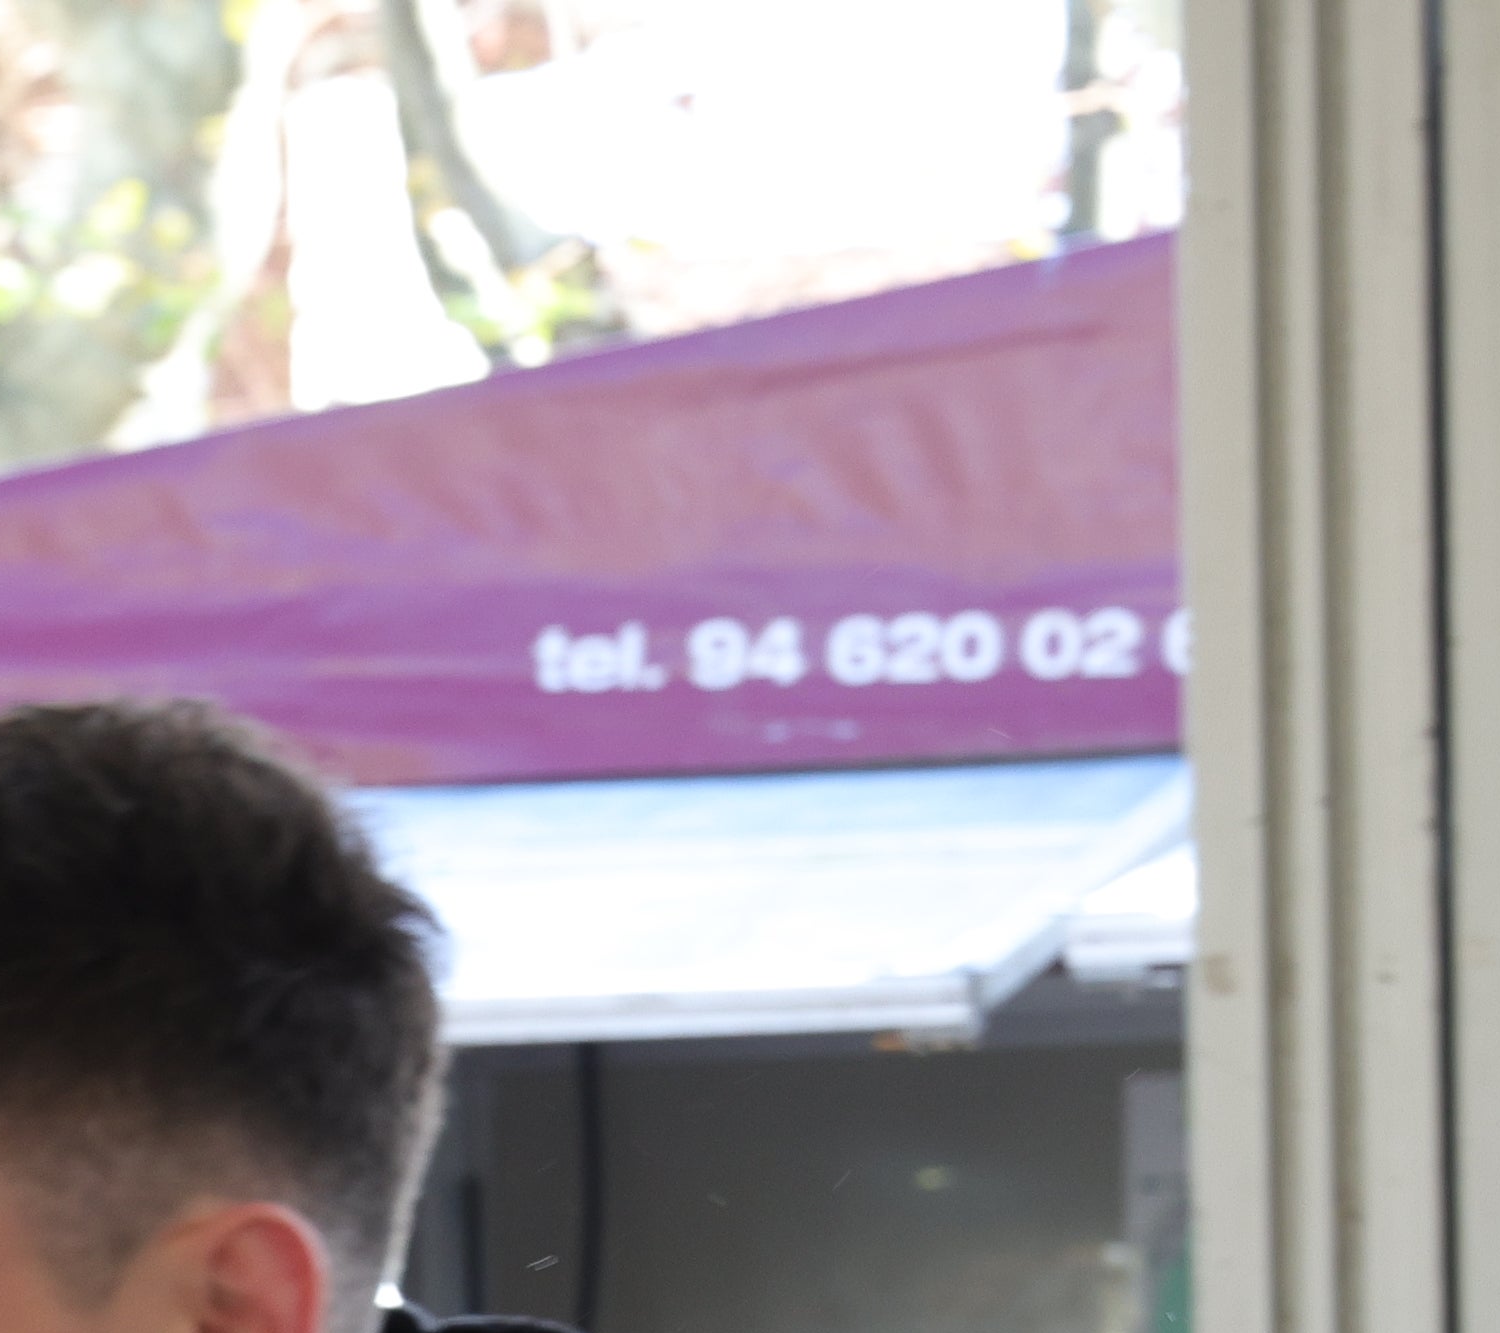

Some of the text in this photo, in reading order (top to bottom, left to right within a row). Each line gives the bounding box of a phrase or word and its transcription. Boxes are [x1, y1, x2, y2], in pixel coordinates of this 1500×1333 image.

[533, 623, 667, 694] tel.
[686, 616, 806, 691] 94
[826, 610, 1002, 687] 620
[1020, 606, 1142, 682] 02
